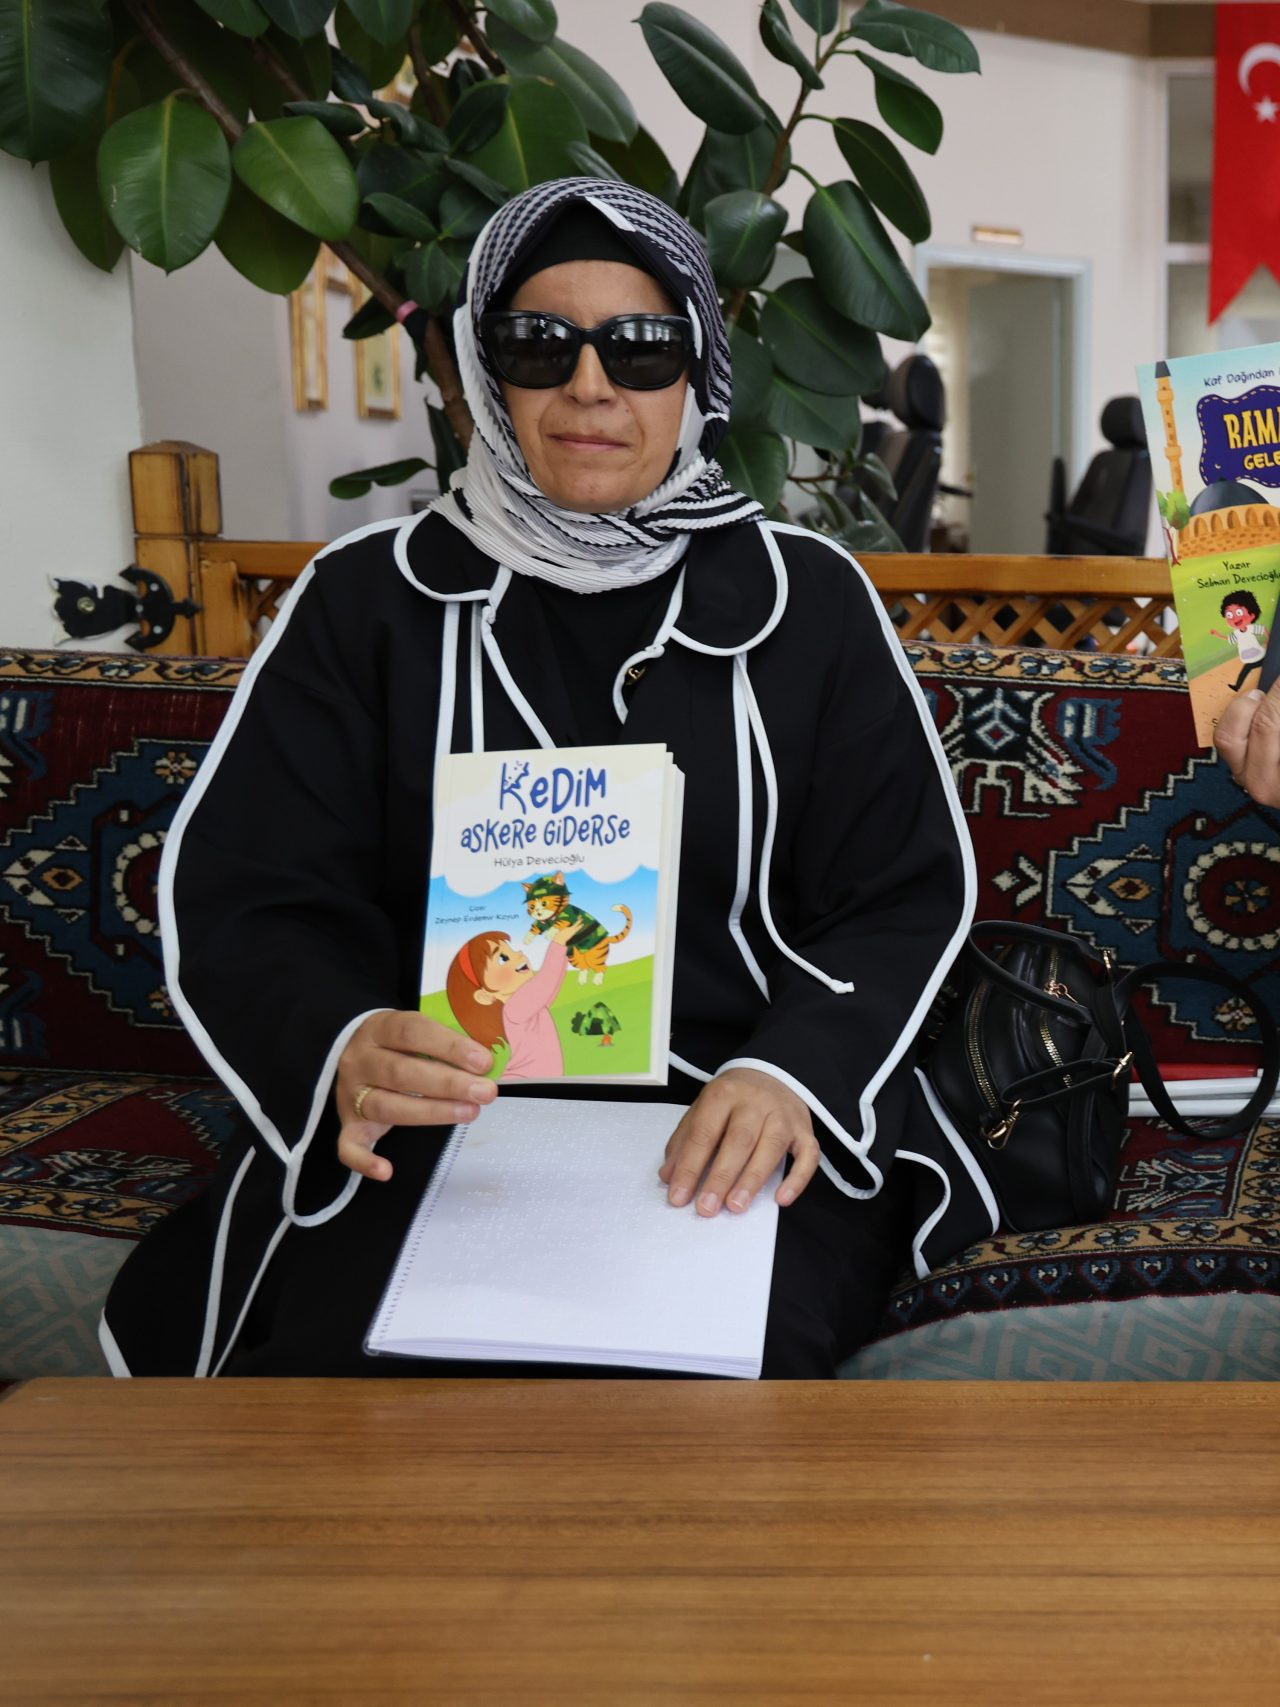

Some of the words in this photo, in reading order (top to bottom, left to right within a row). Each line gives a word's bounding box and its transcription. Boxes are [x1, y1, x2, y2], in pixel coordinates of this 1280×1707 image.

[1203, 375, 1222, 387] Kaf
[1227, 369, 1275, 384] Dağından
[1222, 560, 1252, 571] Yazar
[1197, 577, 1231, 589] Selman
[494, 856, 523, 869] Hülya
[526, 853, 585, 867] Devecioğlu
